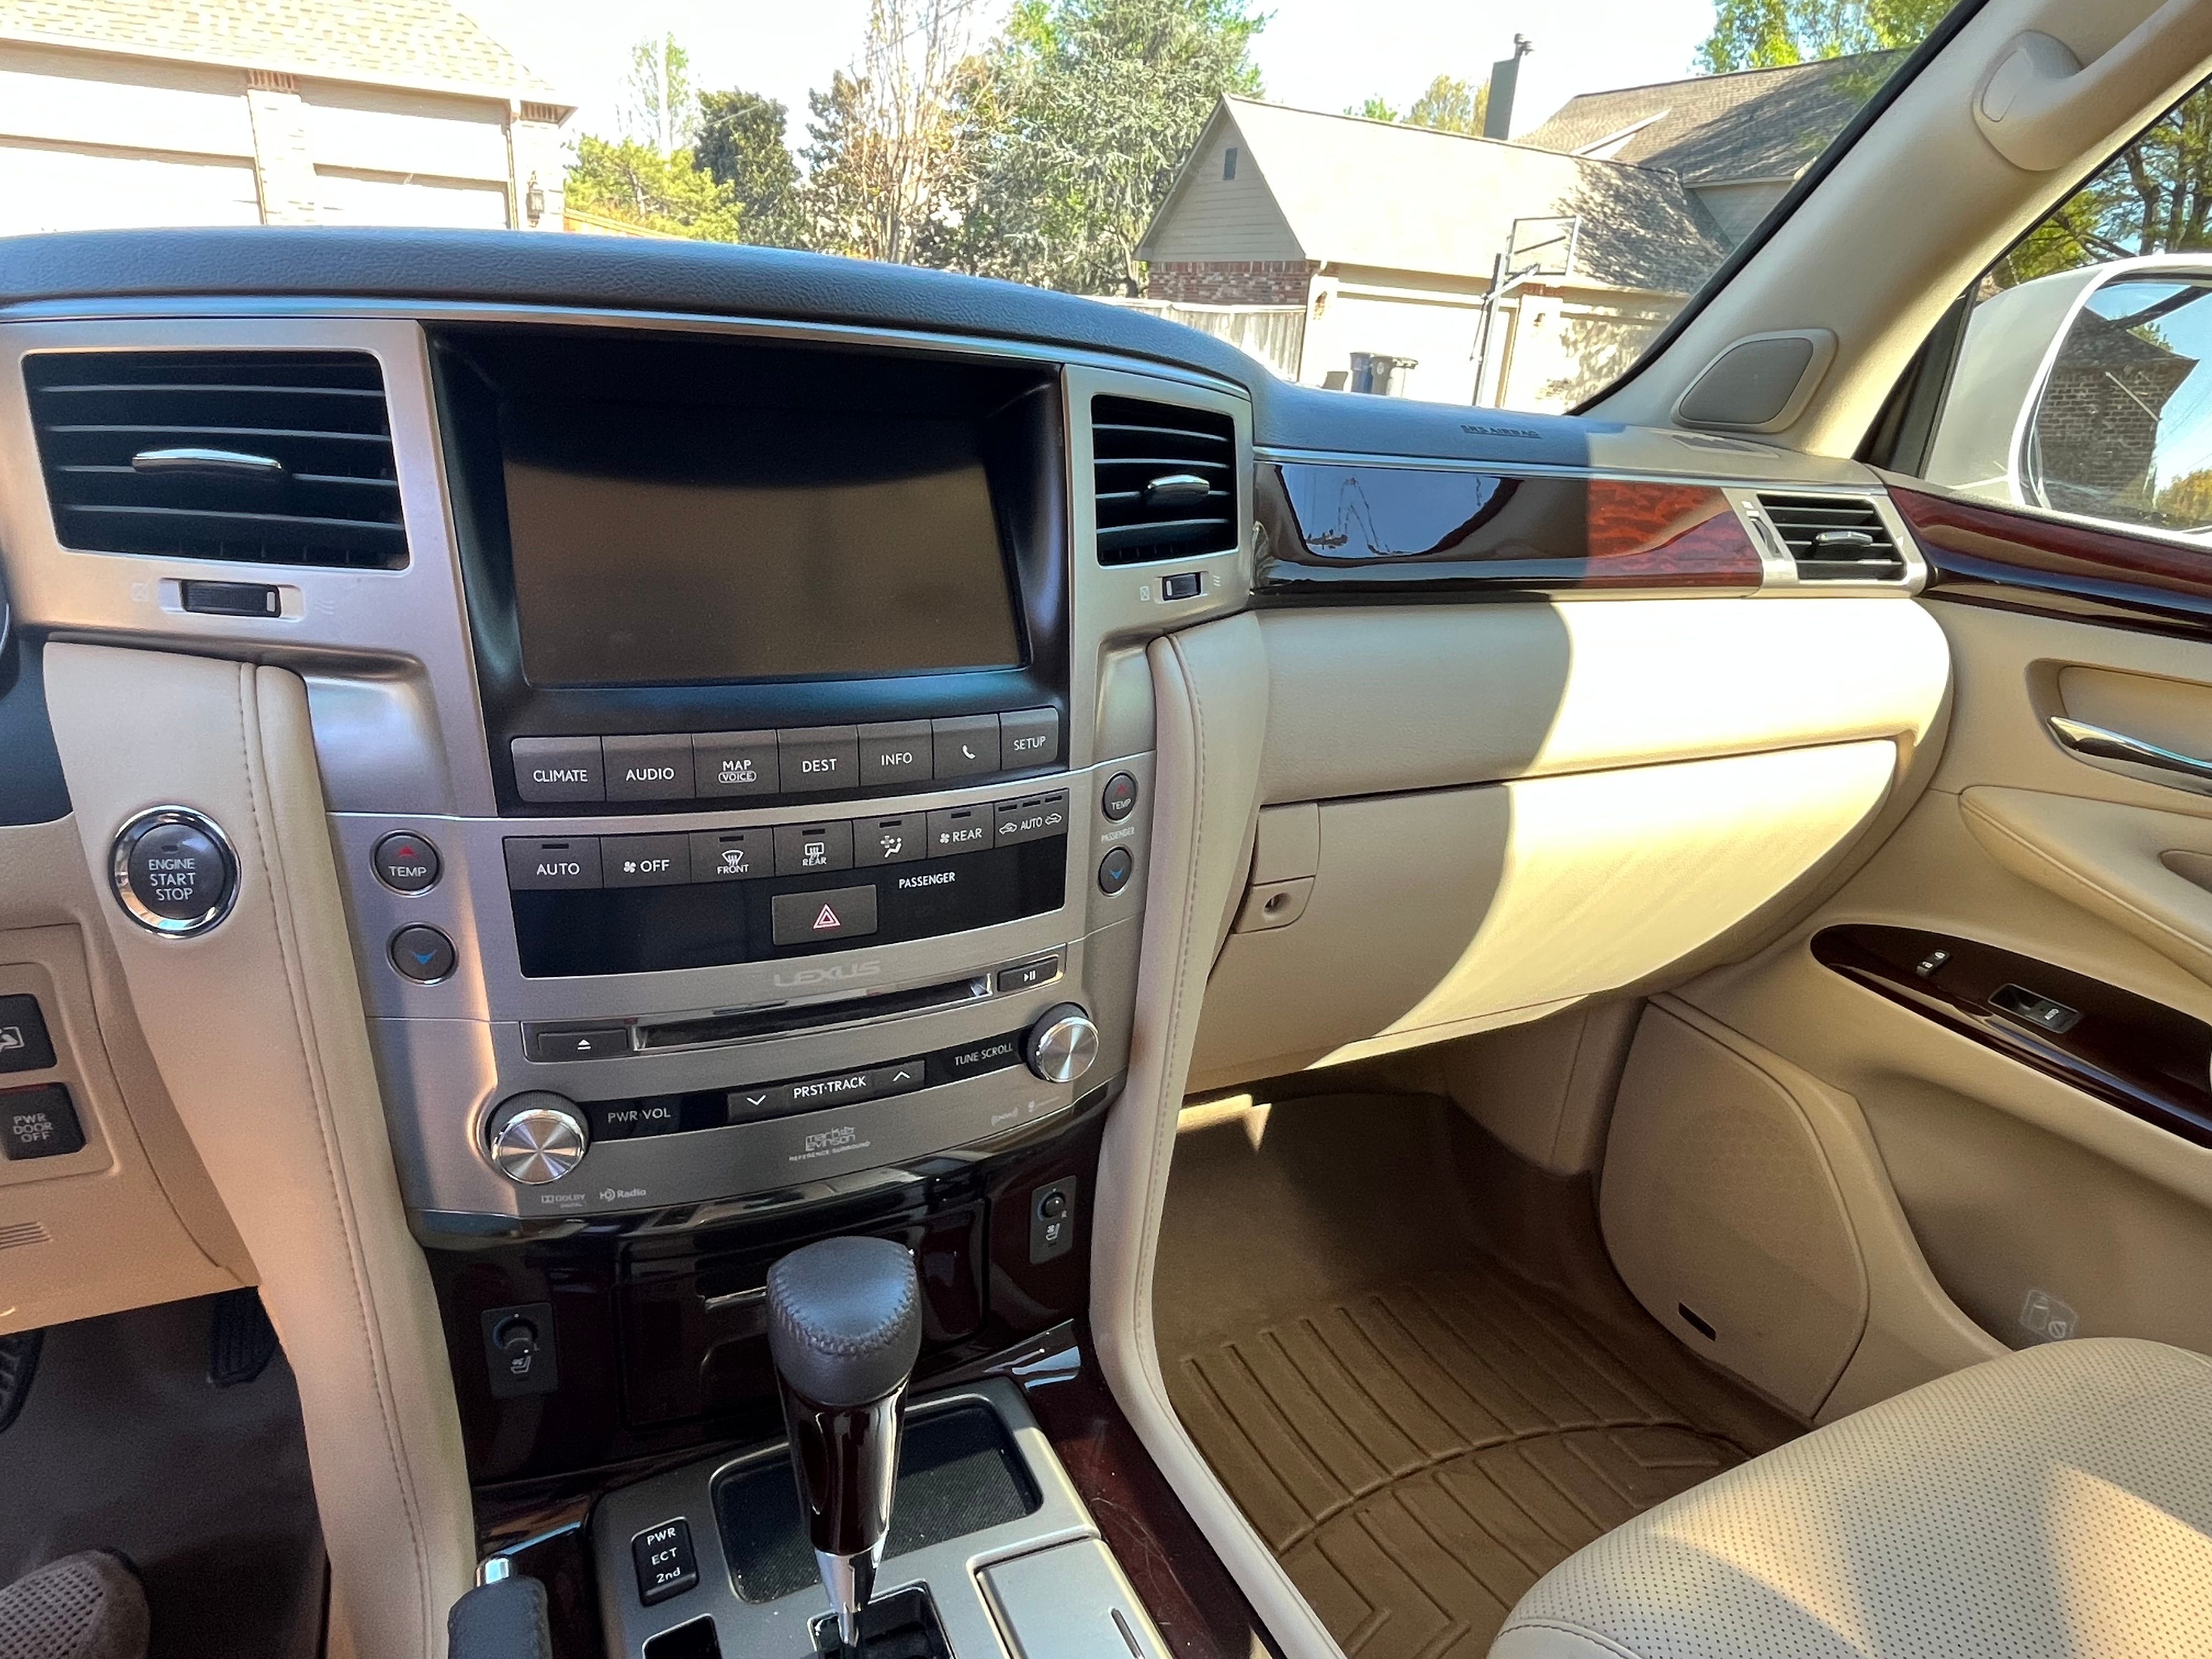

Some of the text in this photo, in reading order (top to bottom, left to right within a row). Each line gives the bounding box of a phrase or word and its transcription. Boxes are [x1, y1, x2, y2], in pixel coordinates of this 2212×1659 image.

[1013, 736, 1046, 751] SETUP
[723, 760, 752, 771] MAP
[802, 759, 837, 772] DEST
[881, 752, 912, 766] INFO
[533, 770, 588, 782] CLIMATE
[625, 768, 674, 781] AUDIO
[722, 772, 753, 781] VOICE
[1111, 798, 1131, 810] TEMP
[1020, 817, 1042, 831] AUTO
[952, 828, 982, 842] REAR
[1101, 826, 1135, 843] PASSENGER
[148, 858, 195, 871] ENGINE
[640, 860, 670, 872] OFF
[802, 856, 827, 866] REAR
[388, 866, 427, 877] TEMP
[537, 862, 579, 875] AUTO
[717, 864, 749, 874] FRONT
[150, 872, 196, 886] START
[899, 872, 955, 889] PASSENGER
[156, 888, 193, 901] STOP
[774, 960, 880, 986] LEXUS
[13, 1113, 46, 1125] PWR
[608, 1108, 671, 1123] PWR VOL
[13, 1122, 53, 1135] DOOR
[21, 1132, 52, 1143] OFF
[555, 1194, 586, 1202] DOLBY
[617, 1188, 647, 1198] Radio
[647, 1527, 676, 1546] PWR
[651, 1547, 677, 1565] ECT
[656, 1567, 681, 1583] 2nd
